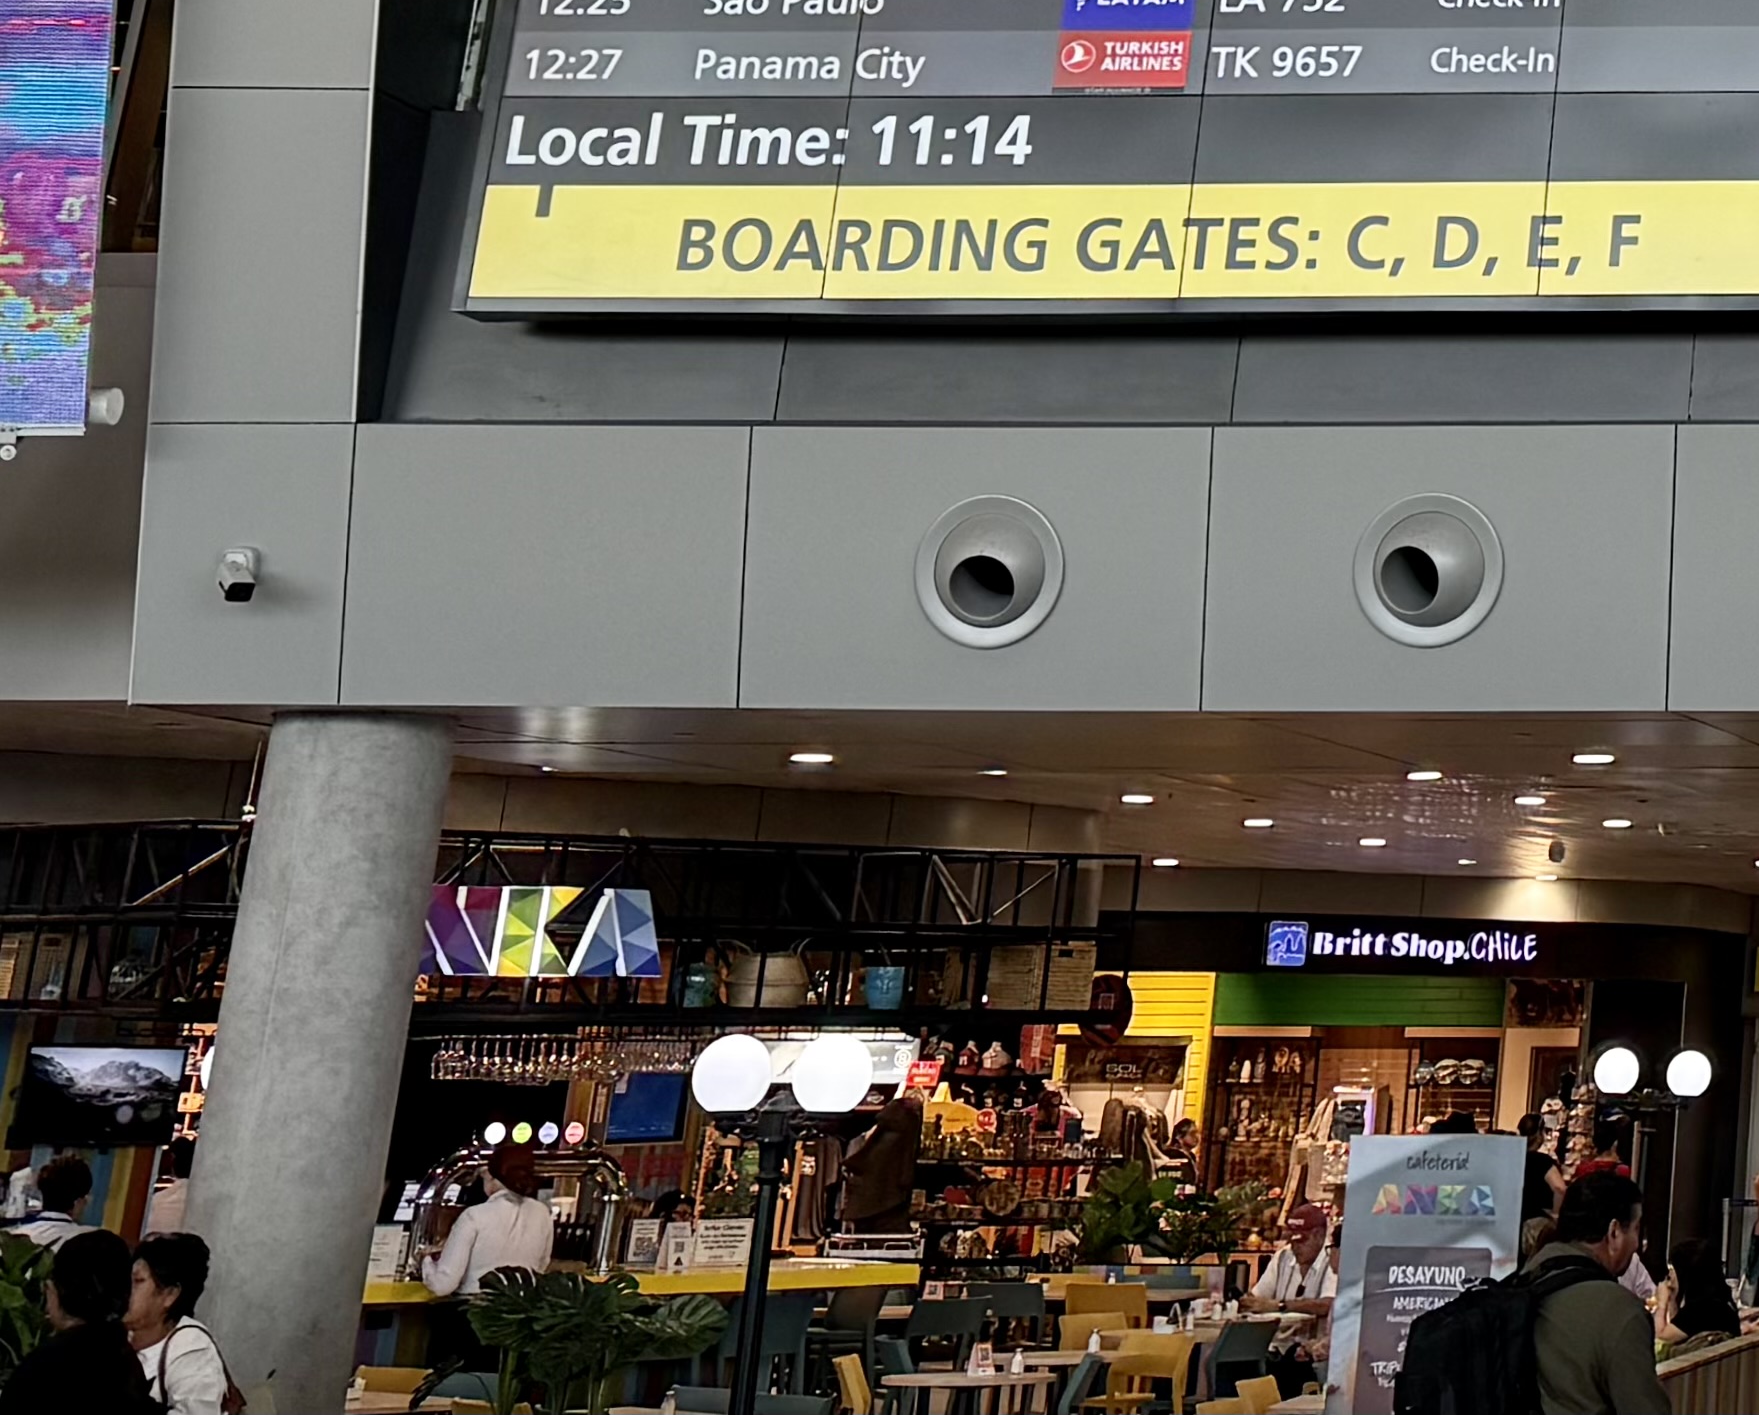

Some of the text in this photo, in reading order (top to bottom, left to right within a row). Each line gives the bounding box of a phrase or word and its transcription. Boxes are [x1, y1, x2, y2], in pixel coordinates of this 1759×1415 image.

[506, 113, 1032, 165] Local Time: 11:14
[677, 209, 1641, 284] BOARDING GATES: C, D, E, F
[1372, 1184, 1495, 1216] ANKA
